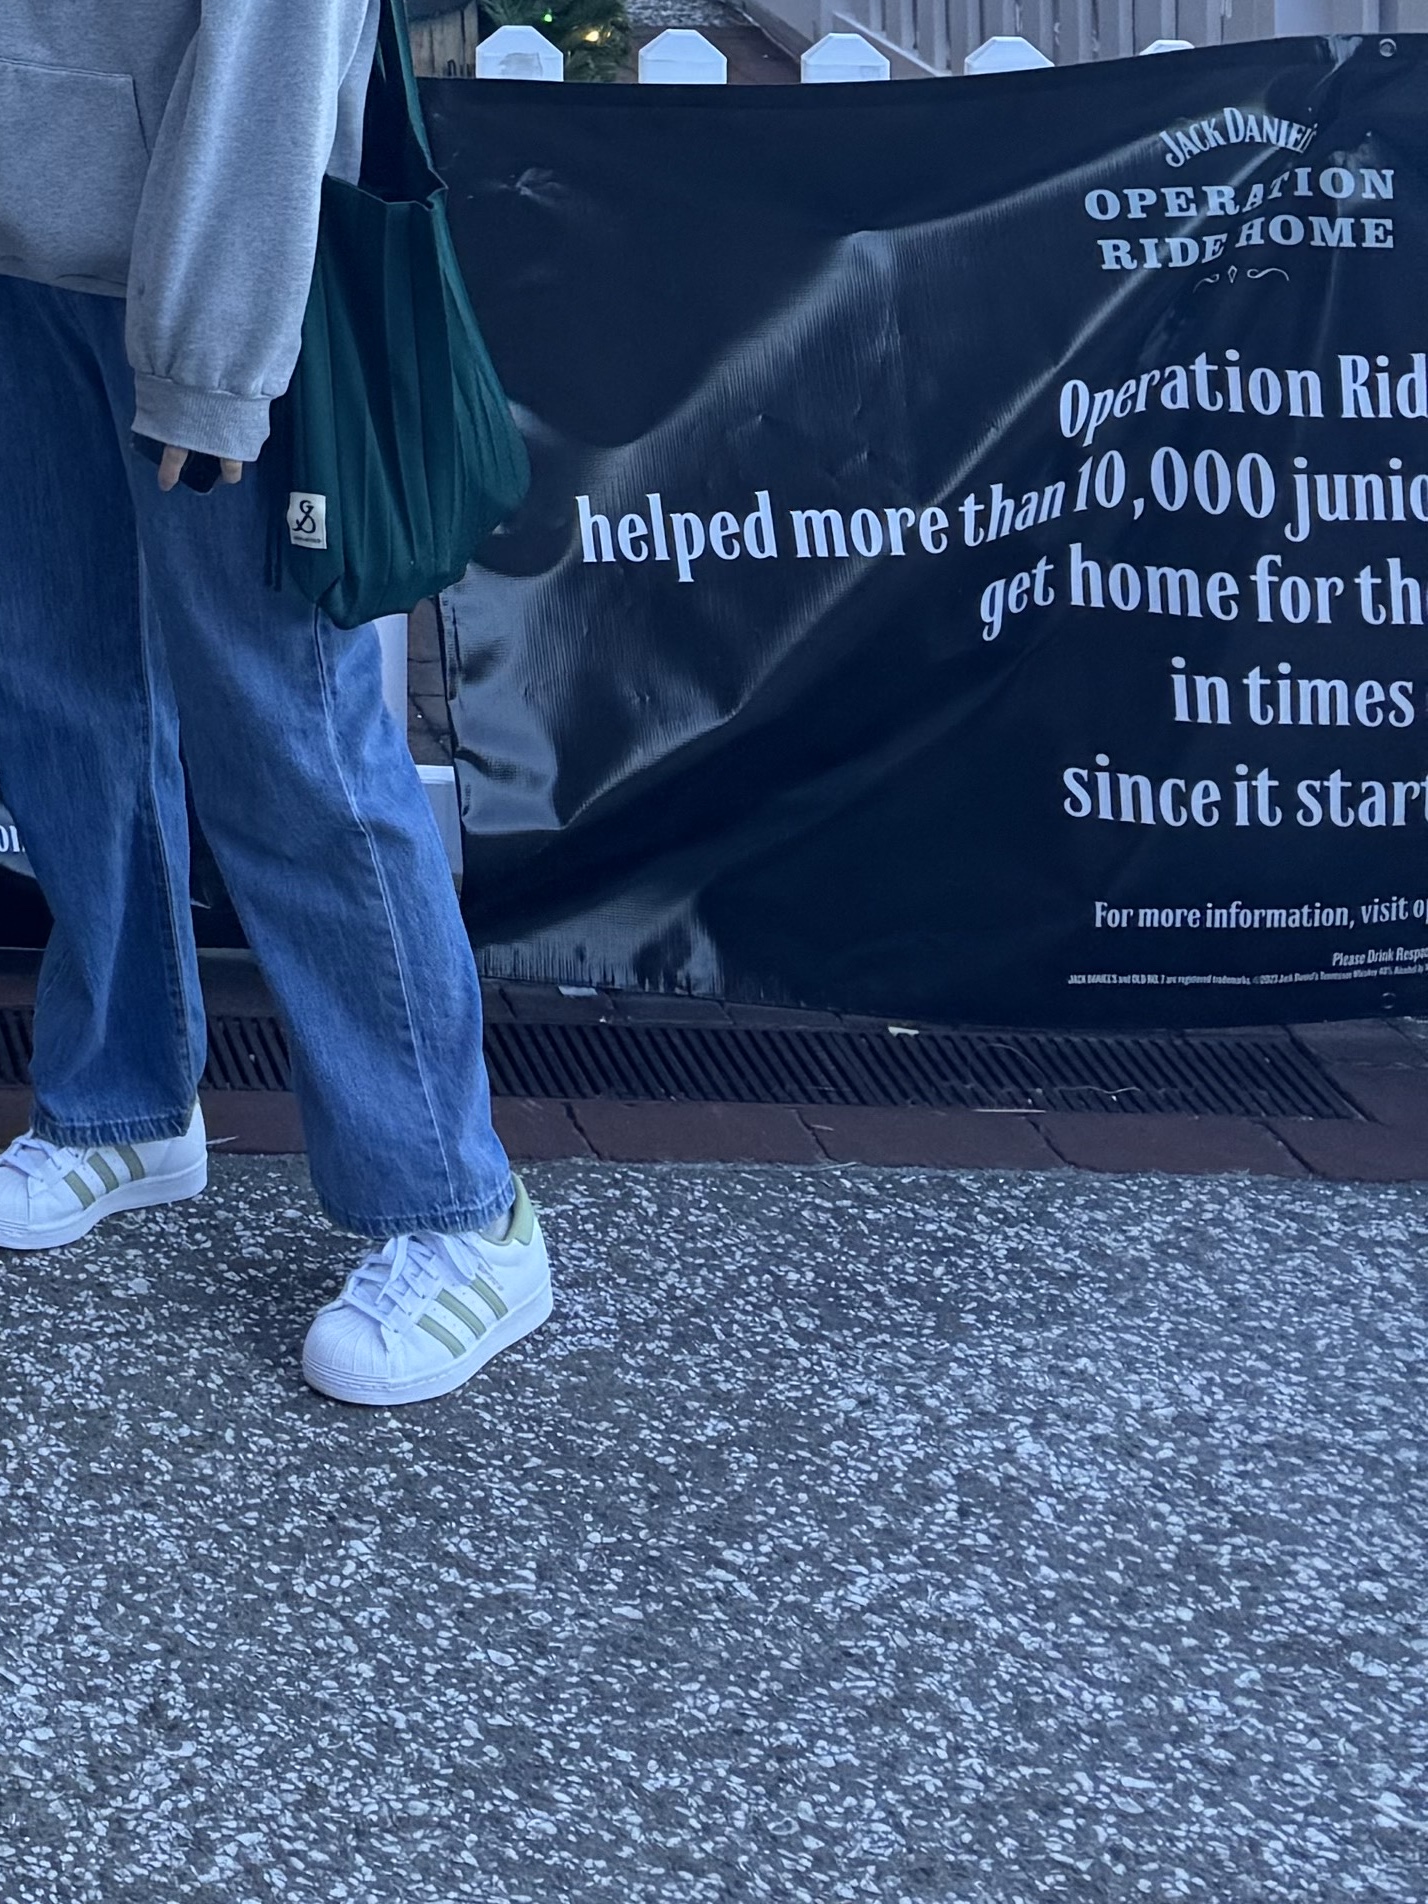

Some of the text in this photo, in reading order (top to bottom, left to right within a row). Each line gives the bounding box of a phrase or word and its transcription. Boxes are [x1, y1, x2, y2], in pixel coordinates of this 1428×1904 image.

[1159, 117, 1226, 168] JACK
[1084, 167, 1394, 221] OPERATION
[1097, 214, 1394, 270] RIDE HOME
[1059, 349, 1324, 447] Operation
[575, 490, 778, 583] helped
[789, 505, 949, 559] more
[958, 480, 1066, 548] than
[1073, 446, 1276, 520] 10,000
[980, 542, 1428, 641] get home for th
[1170, 656, 1416, 727] in times
[1062, 753, 1428, 827] since it star
[1094, 901, 1134, 928] For
[1138, 907, 1200, 928] more
[1205, 900, 1355, 930] information,
[1360, 896, 1409, 924] visit
[1332, 952, 1366, 967] Please
[1367, 947, 1394, 964] Drink
